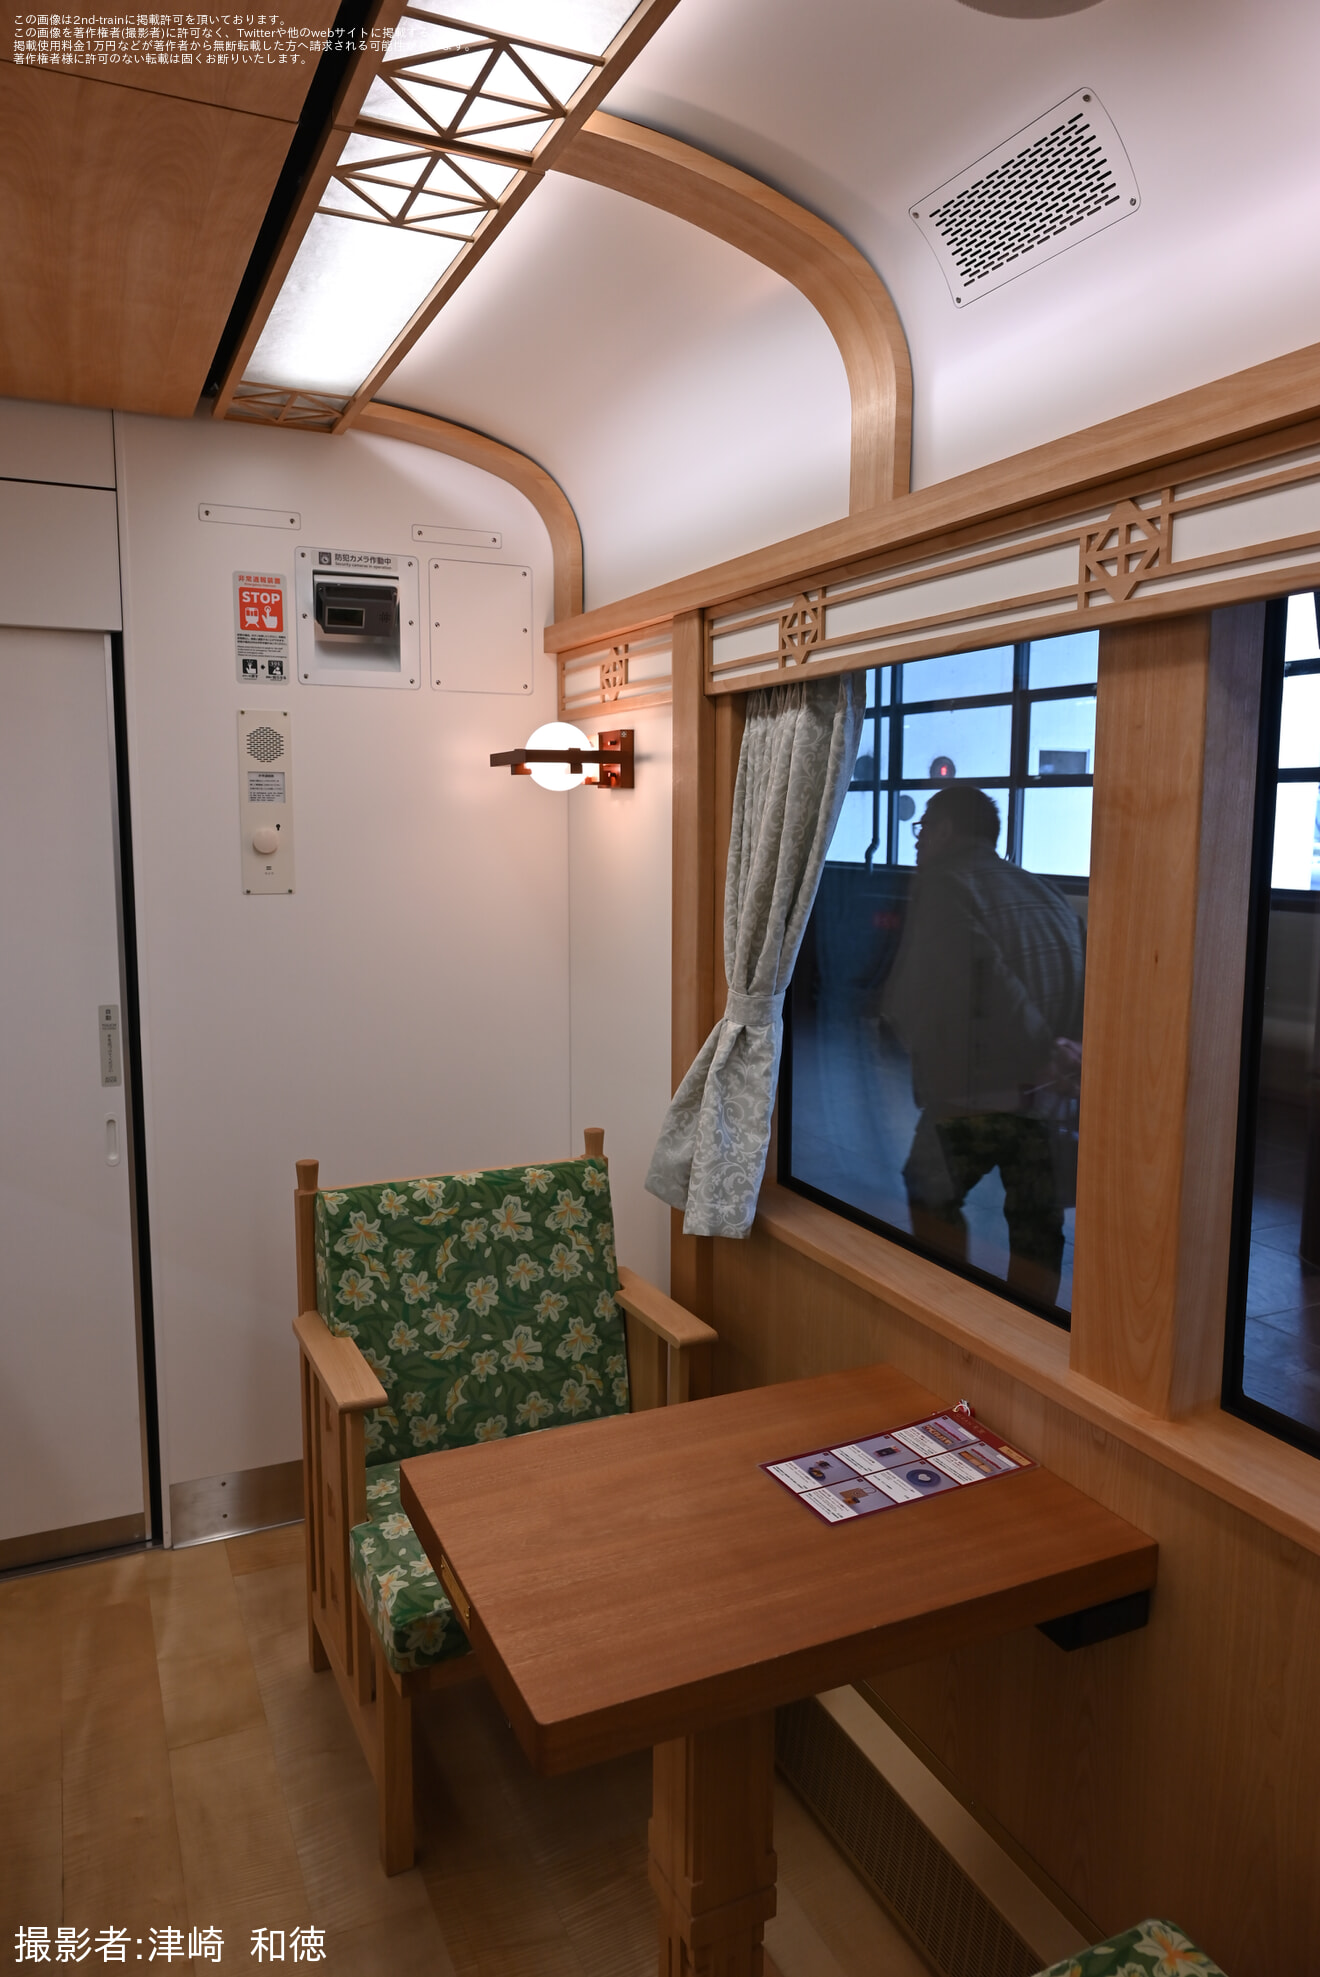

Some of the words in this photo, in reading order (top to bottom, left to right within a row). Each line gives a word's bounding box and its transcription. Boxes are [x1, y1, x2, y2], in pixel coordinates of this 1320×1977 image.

[335, 553, 392, 565] 防犯カメラ作動中
[242, 591, 281, 604] STOP
